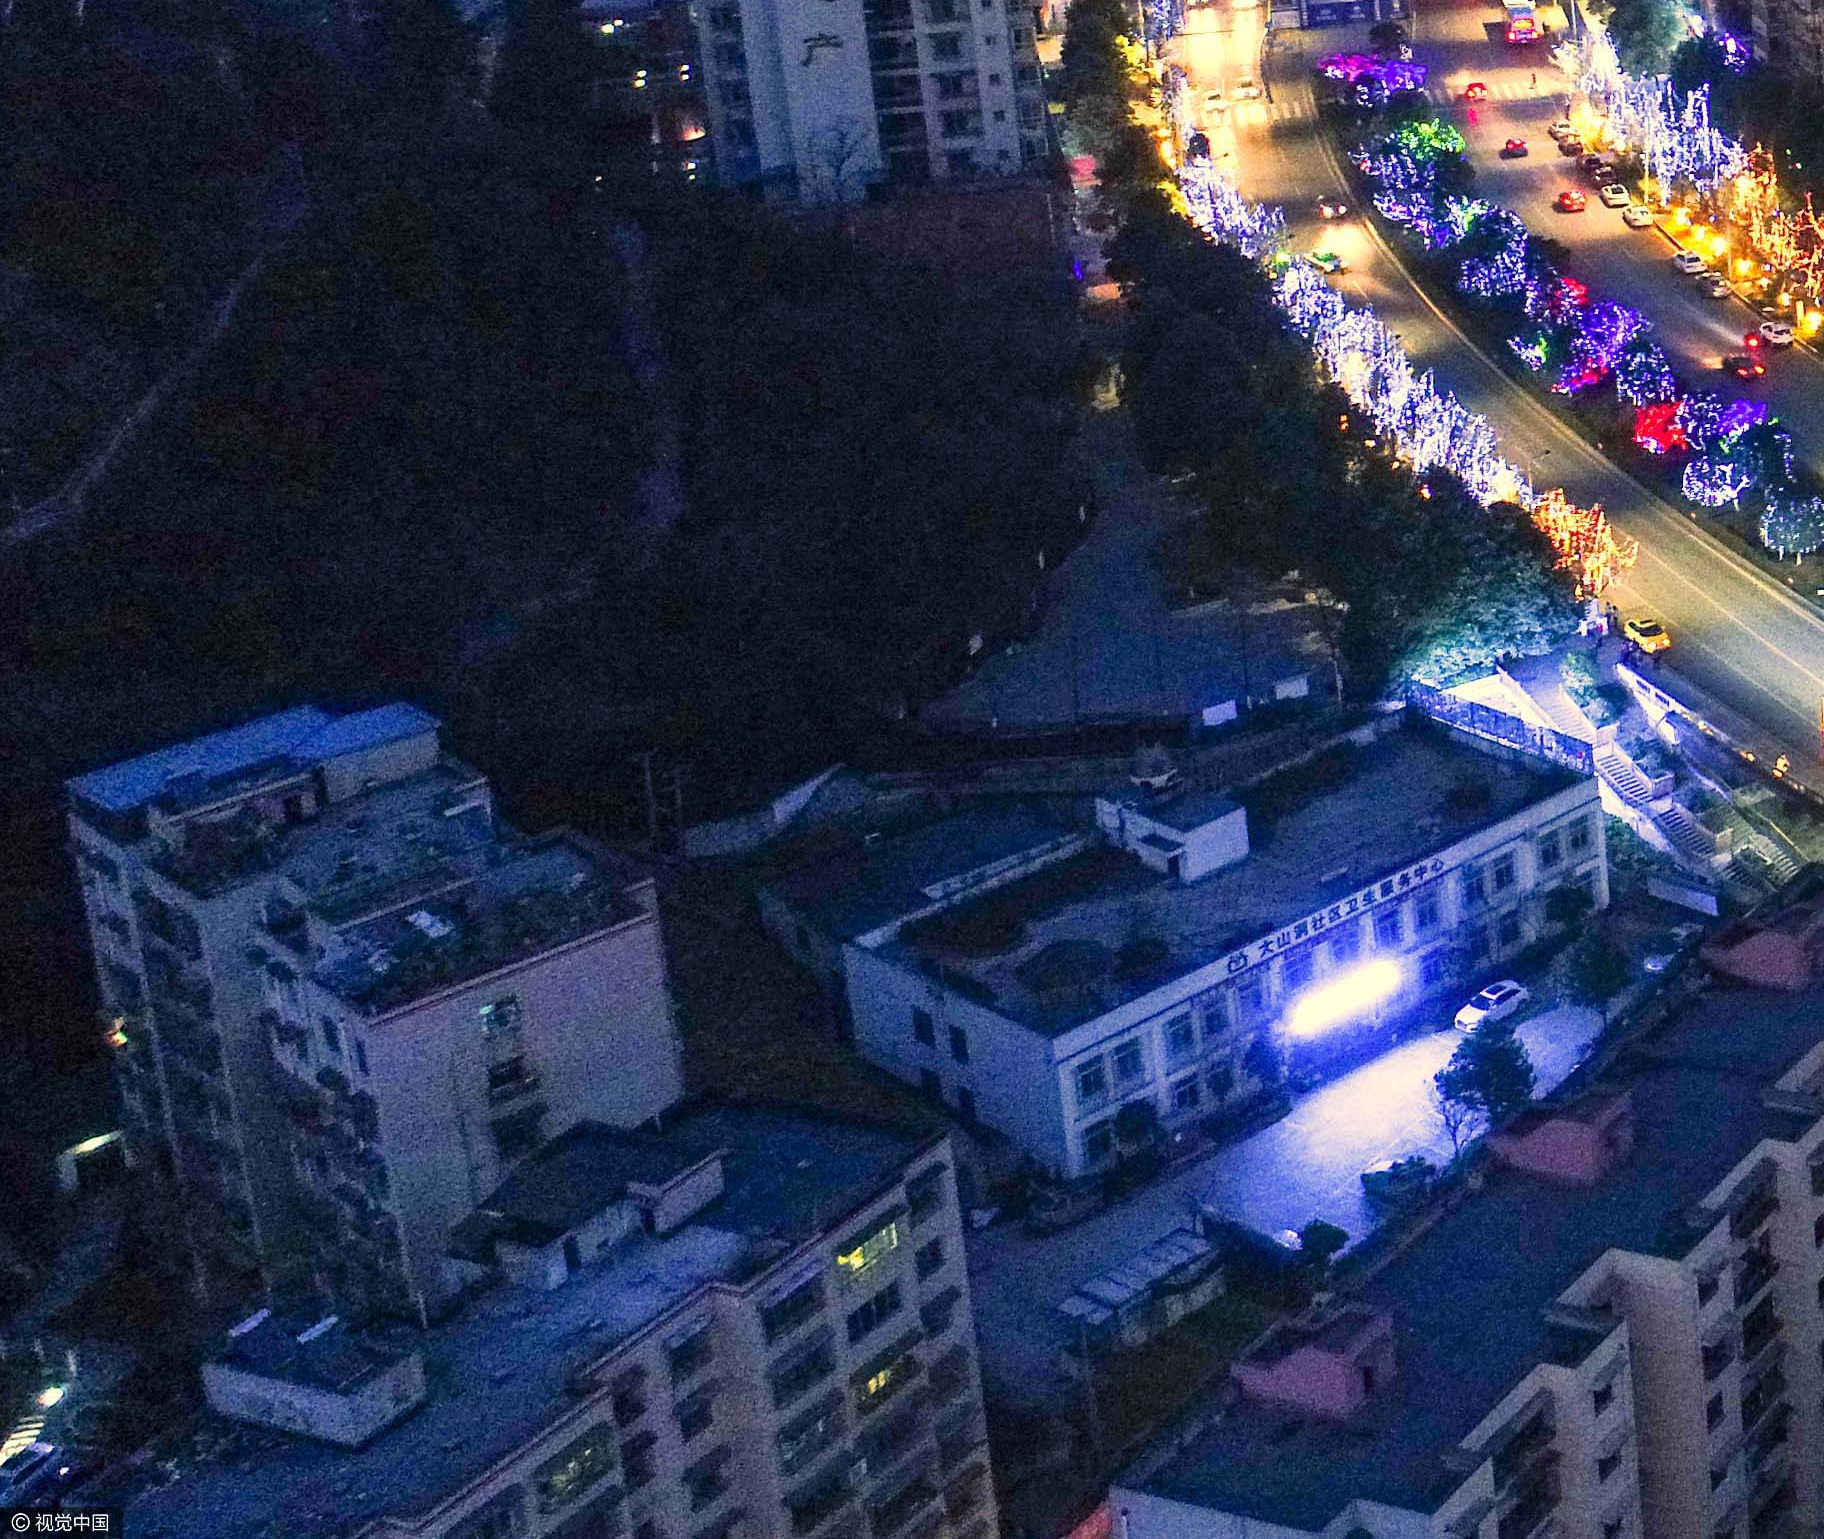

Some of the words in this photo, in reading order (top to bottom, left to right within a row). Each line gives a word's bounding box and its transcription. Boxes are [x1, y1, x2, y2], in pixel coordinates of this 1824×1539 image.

[1257, 858, 1445, 958] 大山洞社区卫生服务中心
